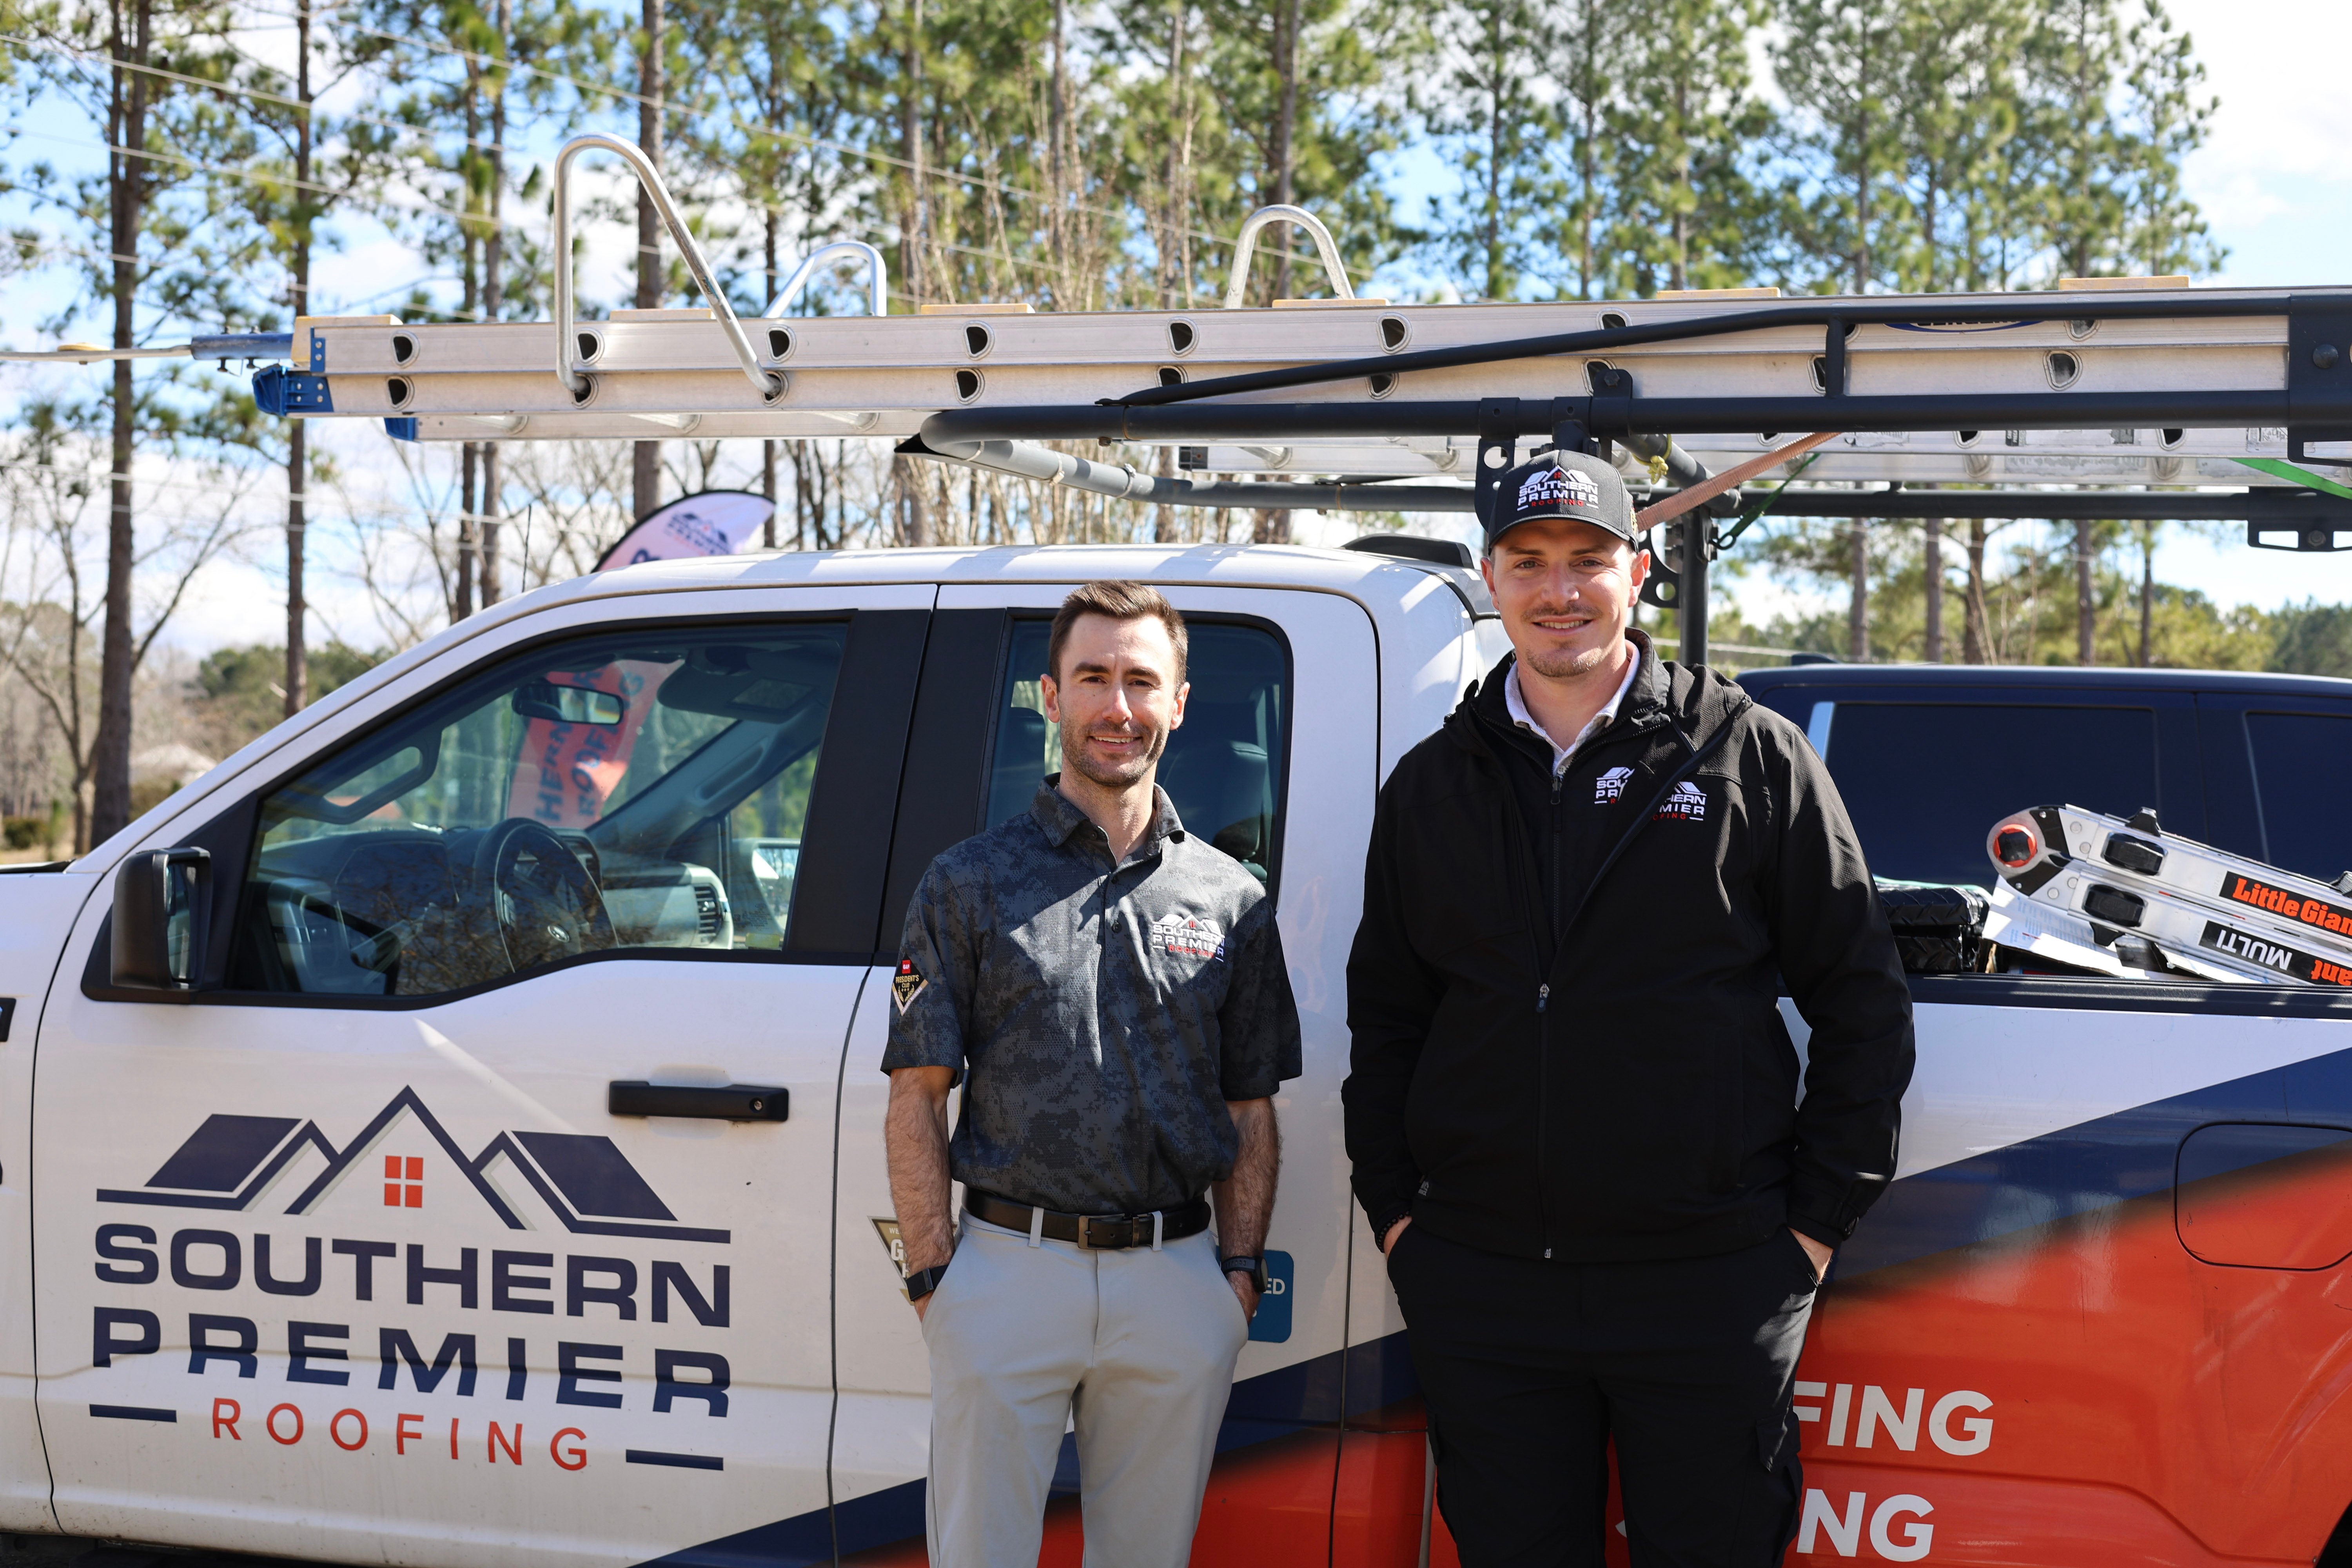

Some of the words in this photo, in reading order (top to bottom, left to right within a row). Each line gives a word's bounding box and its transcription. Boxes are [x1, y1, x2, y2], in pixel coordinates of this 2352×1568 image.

[1518, 490, 1598, 506] PREMIER
[1519, 482, 1598, 497] SOUTHERN
[1531, 499, 1584, 507] ROOFING
[2232, 877, 2300, 917] Little
[1152, 924, 1225, 946] SOUTHERN
[1152, 934, 1224, 957] PREMIER
[1168, 944, 1214, 958] ROOFING
[2216, 929, 2293, 971] MULTI
[895, 974, 919, 984] PRESIDENT'S
[94, 1222, 731, 1328] SOUTHERN
[93, 1306, 731, 1418] PREMIER
[212, 1397, 588, 1471] ROOFING
